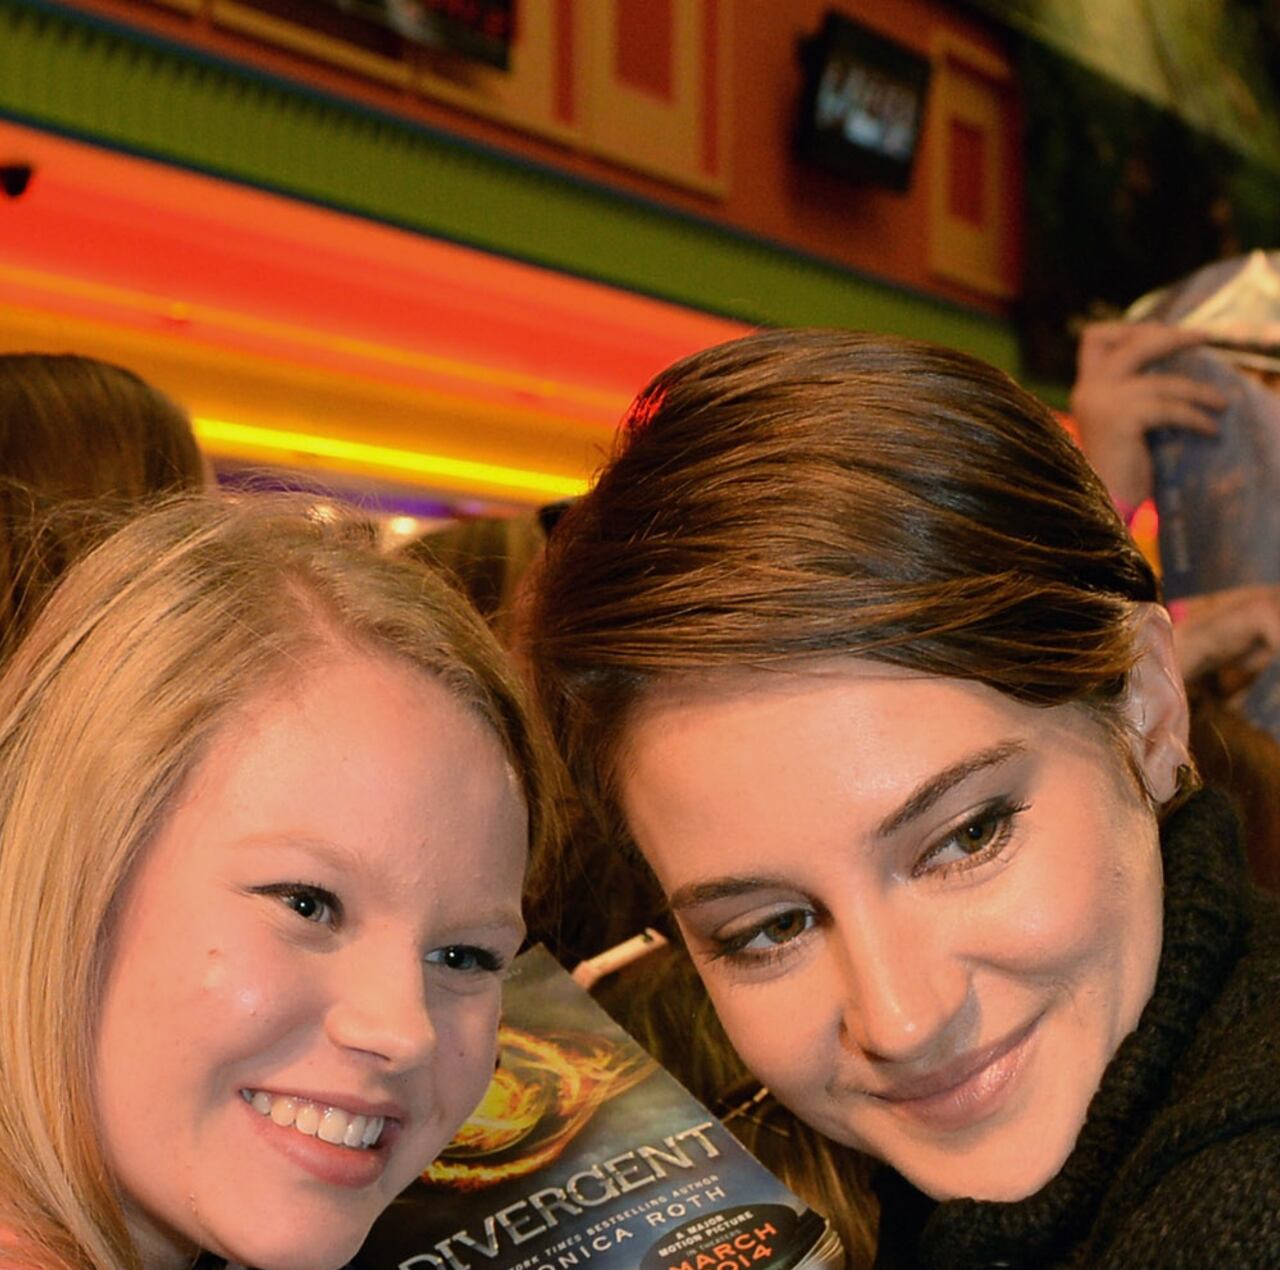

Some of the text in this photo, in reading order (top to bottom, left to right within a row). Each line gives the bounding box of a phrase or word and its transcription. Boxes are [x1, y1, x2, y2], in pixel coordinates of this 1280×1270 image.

[544, 1233, 582, 1256] TIMES
[586, 1195, 668, 1236] BESTSELLING
[671, 1174, 719, 1198] AUTHOR
[645, 1185, 726, 1227] ROTH
[675, 1214, 725, 1240] A MAJOR
[658, 1210, 755, 1258] MOTION PICTURE
